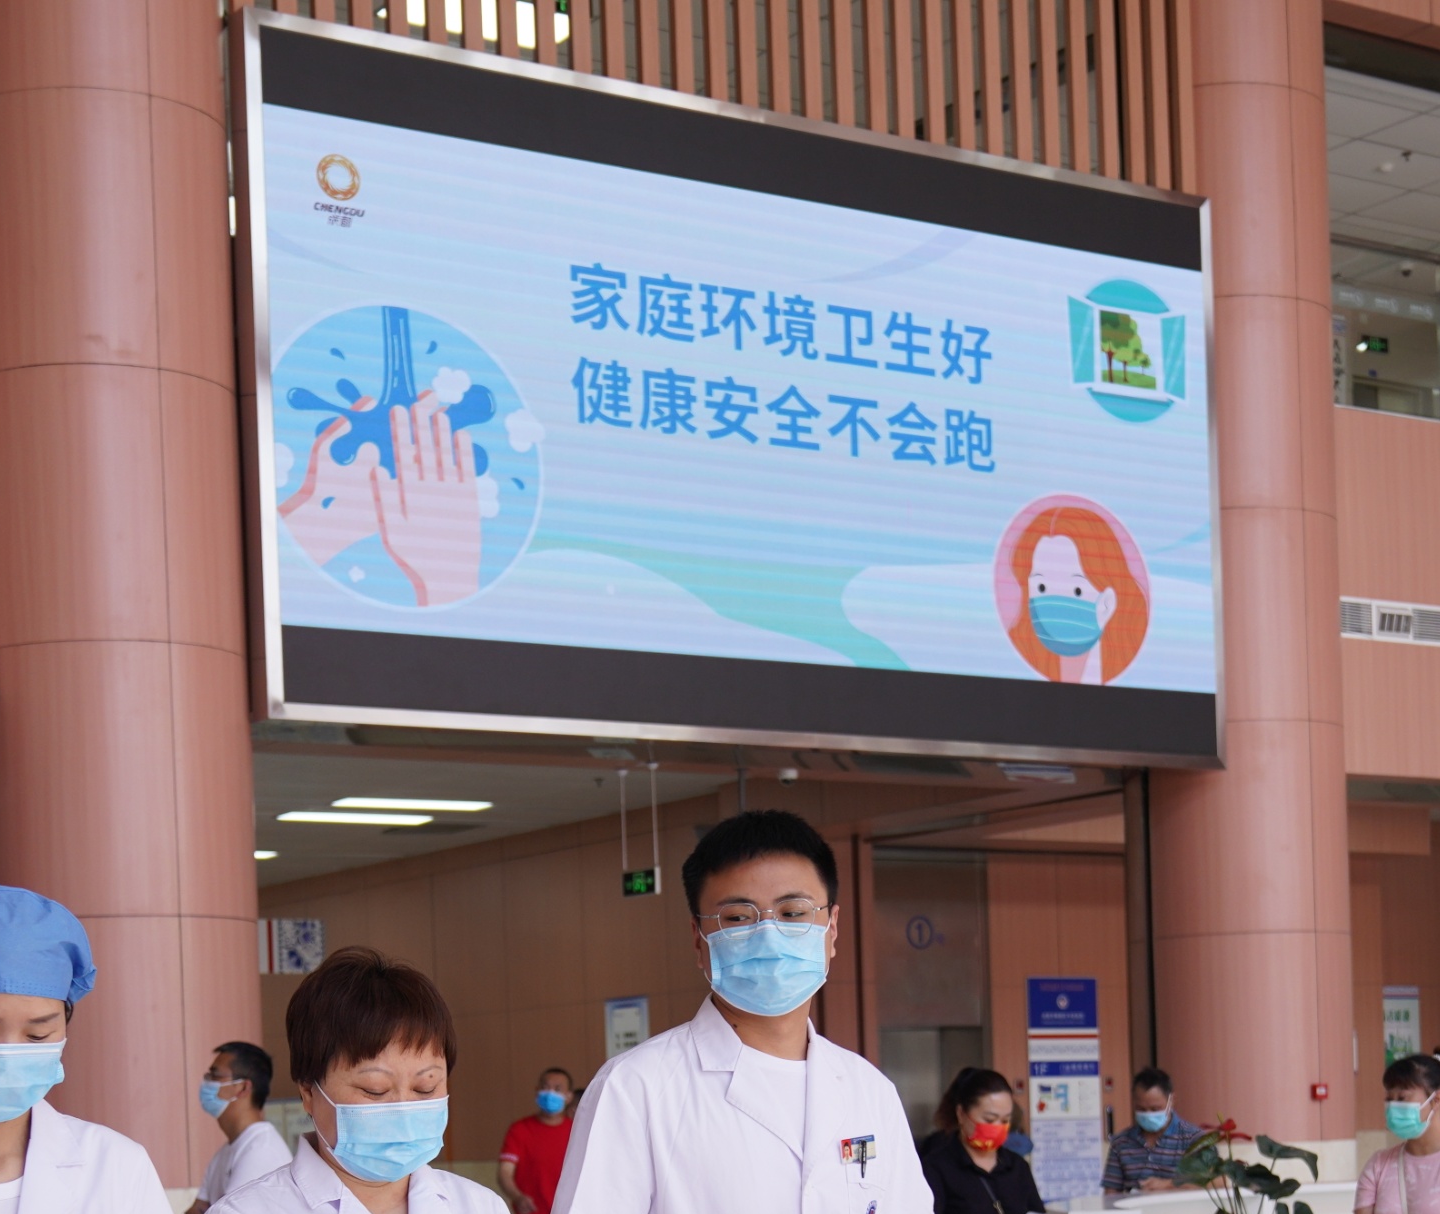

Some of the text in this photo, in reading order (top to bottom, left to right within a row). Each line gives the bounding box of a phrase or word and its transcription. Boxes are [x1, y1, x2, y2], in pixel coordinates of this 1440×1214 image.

[314, 202, 365, 218] CHENGDU
[569, 261, 993, 385] 家庭环境卫生好
[571, 355, 996, 475] 健康安全不会跑
